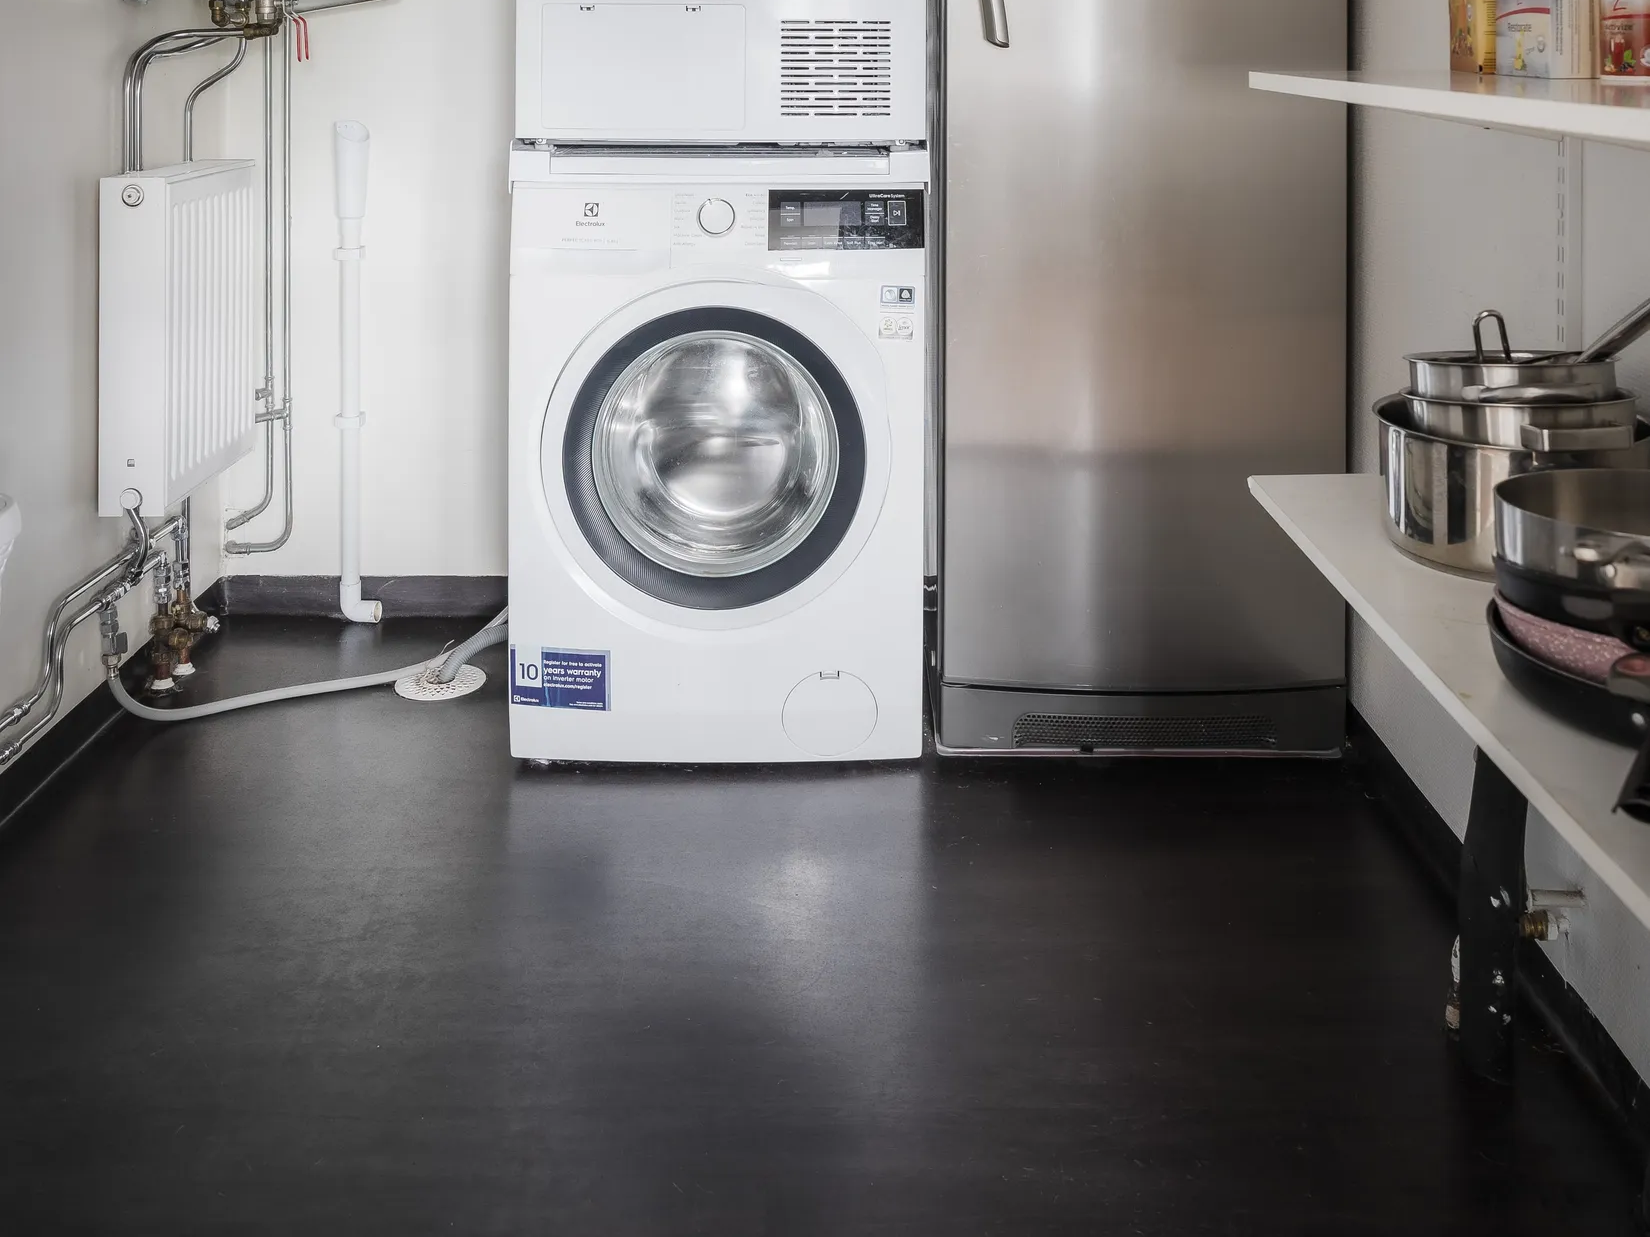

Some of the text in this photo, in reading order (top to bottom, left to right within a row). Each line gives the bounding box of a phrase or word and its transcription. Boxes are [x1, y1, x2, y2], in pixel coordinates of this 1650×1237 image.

[518, 662, 539, 681] 10
[543, 667, 602, 679] years warranty
[552, 675, 575, 683] inverter
